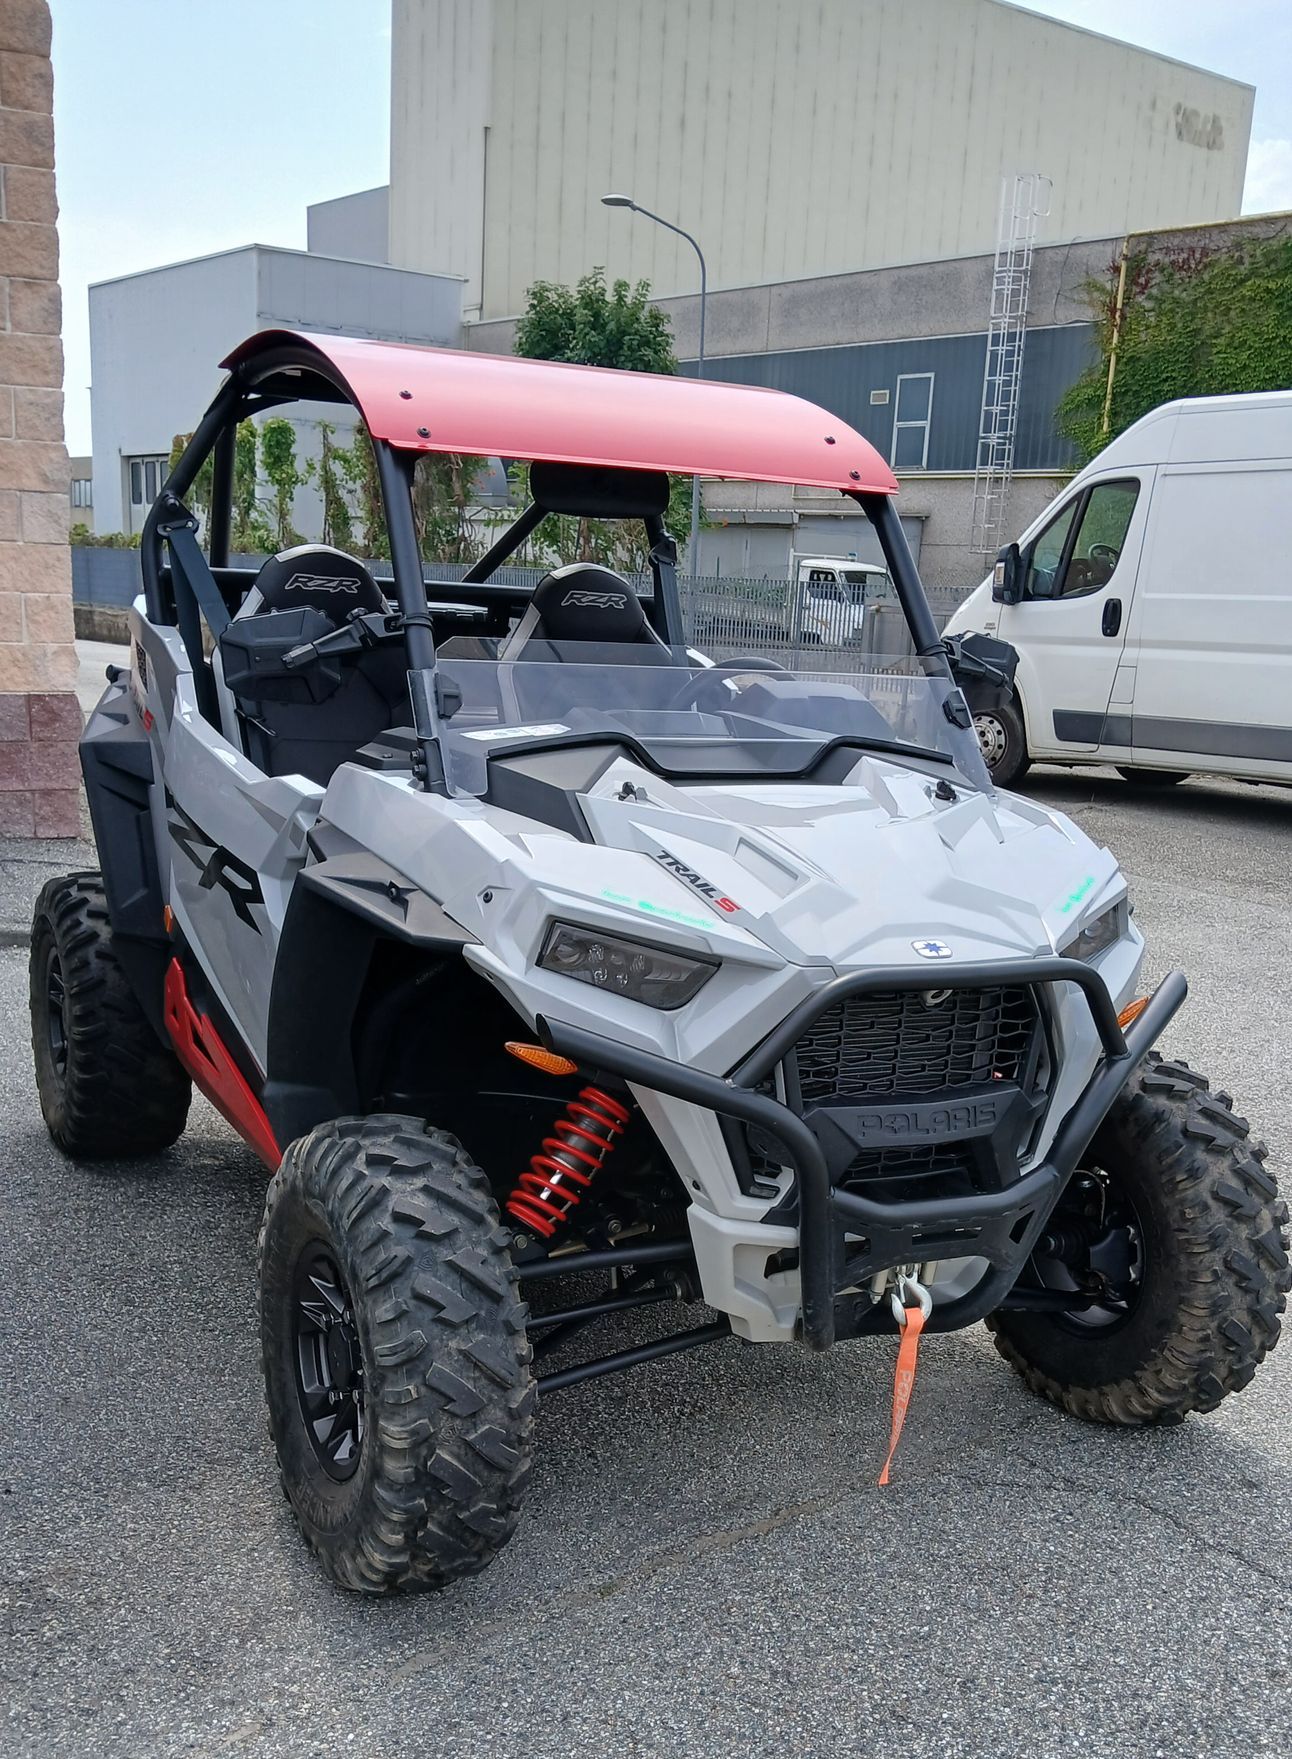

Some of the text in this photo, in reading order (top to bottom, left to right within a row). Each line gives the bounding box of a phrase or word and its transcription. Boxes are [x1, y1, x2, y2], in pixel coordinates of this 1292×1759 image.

[284, 572, 362, 594] RZR
[561, 590, 628, 609] RZR
[164, 782, 265, 937] ZR
[655, 850, 717, 899] TRAIL
[714, 897, 741, 913] S
[856, 1101, 997, 1138] POLARIS
[890, 1369, 913, 1446] POLA
